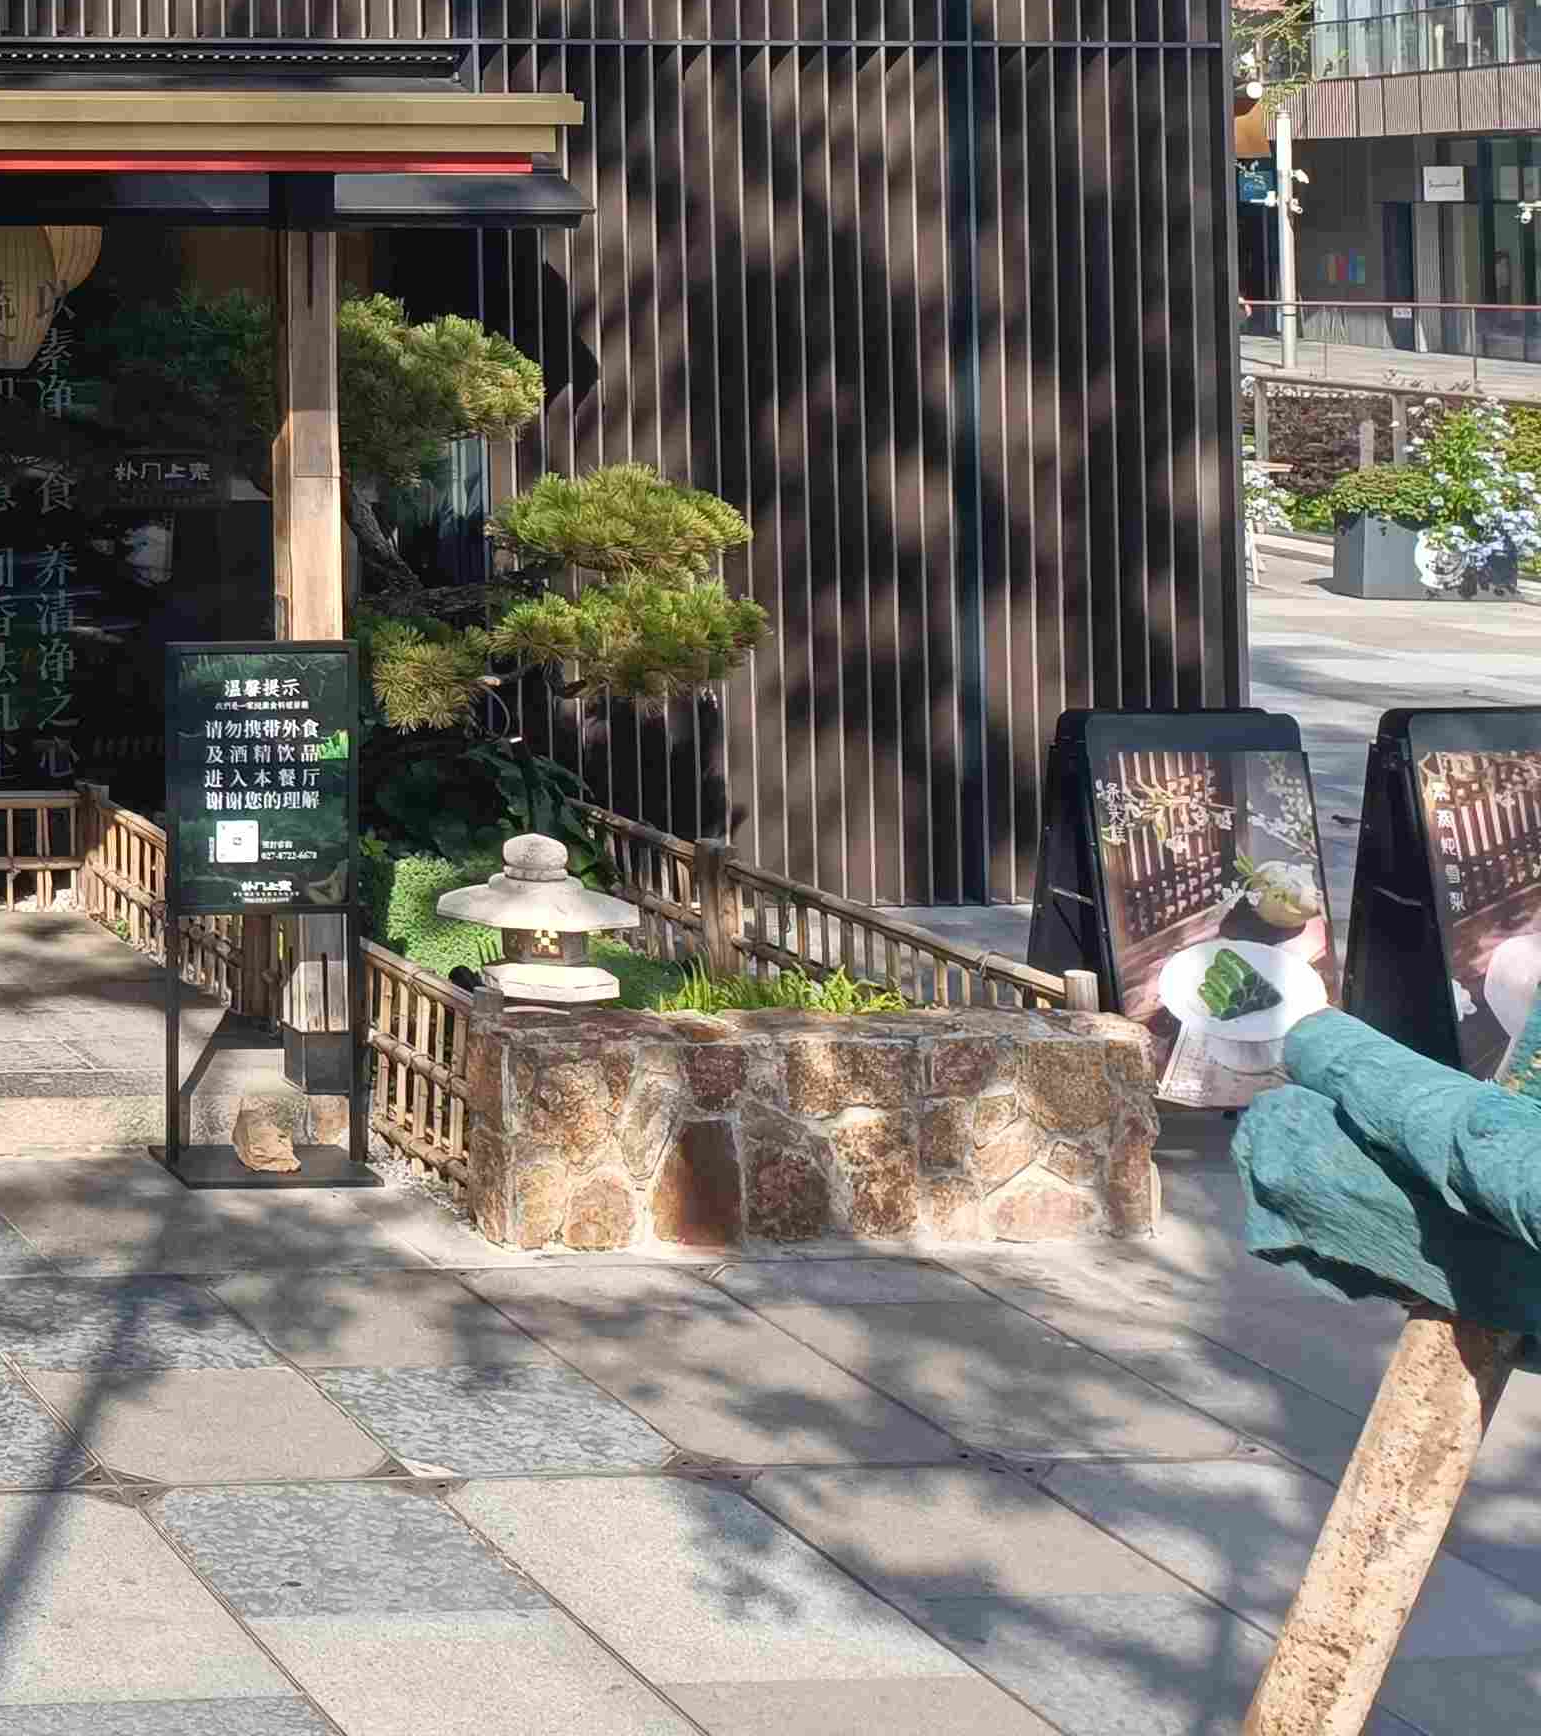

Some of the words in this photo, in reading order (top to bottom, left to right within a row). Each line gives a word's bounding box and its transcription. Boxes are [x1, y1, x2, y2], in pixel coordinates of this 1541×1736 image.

[204, 719, 320, 740] 请勿携带外食
[205, 744, 319, 765] 及酒精饮品
[203, 768, 321, 789] 进入本餐厅
[205, 791, 320, 811] 谢谢您的理解
